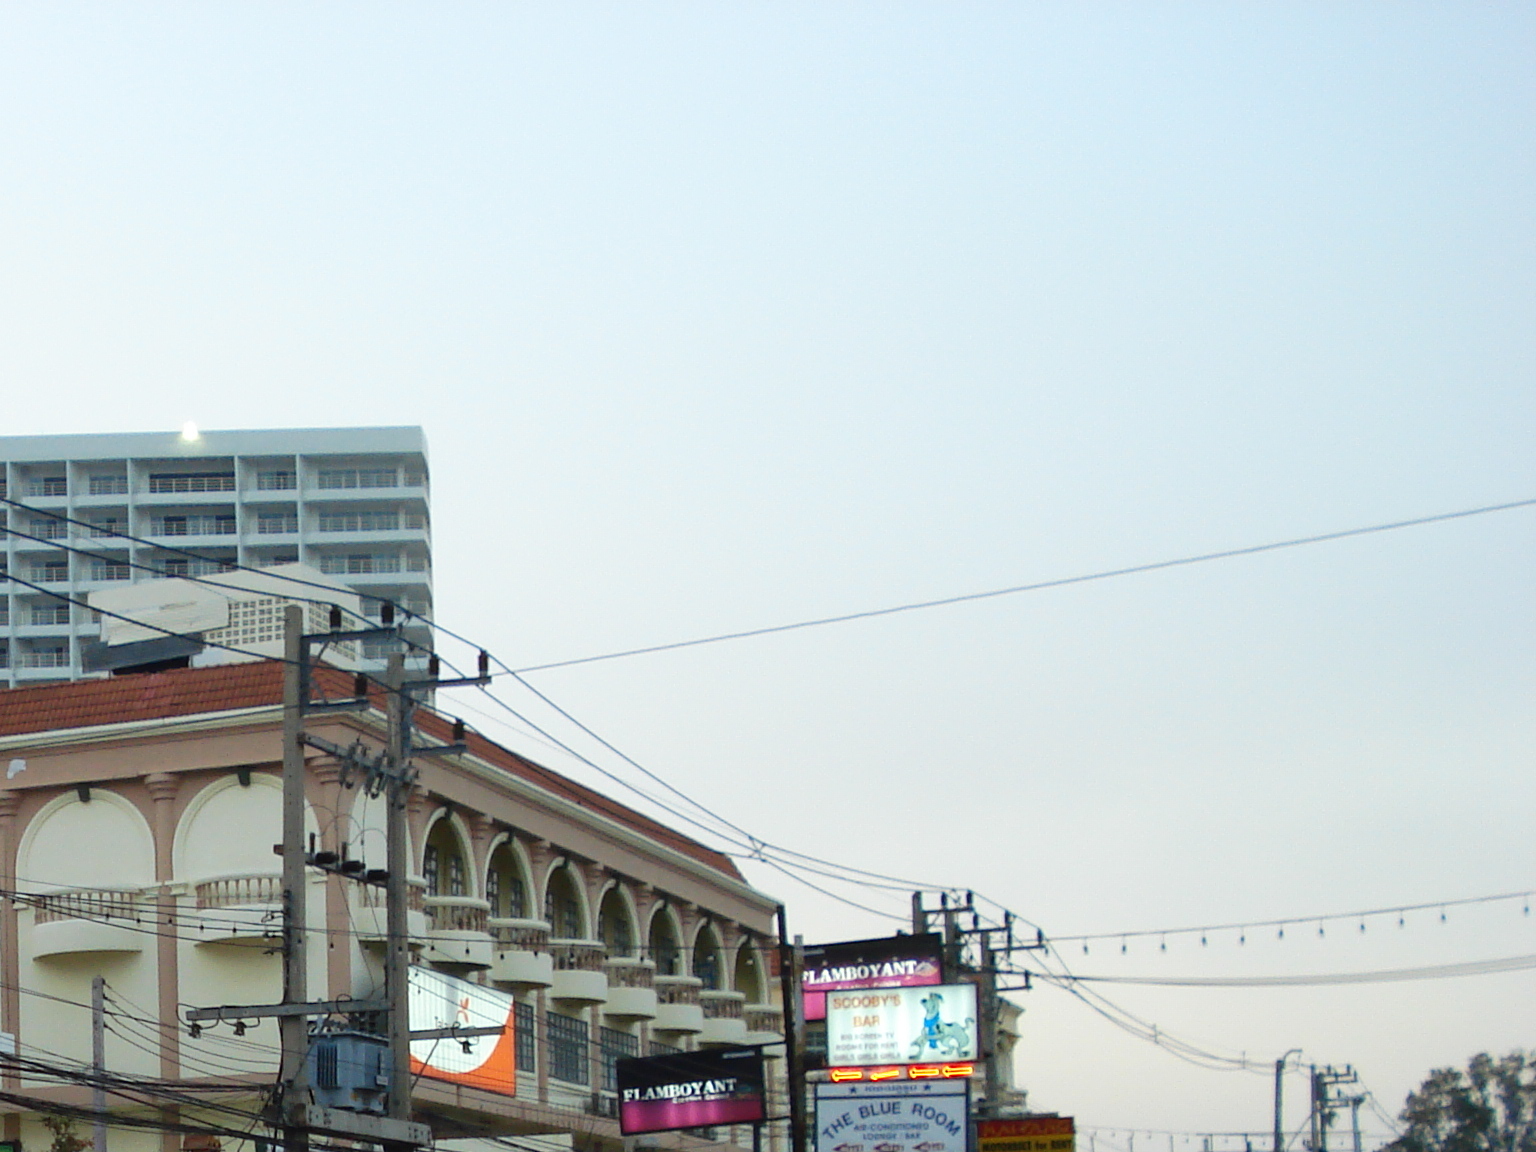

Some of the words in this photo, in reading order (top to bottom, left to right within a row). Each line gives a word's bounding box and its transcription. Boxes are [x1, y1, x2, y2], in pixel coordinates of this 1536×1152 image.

[833, 993, 901, 1010] SCOOBY'S
[853, 1015, 880, 1028] BAR
[622, 1077, 738, 1102] FLAMBOYANT
[822, 1111, 855, 1140] THE
[858, 1101, 902, 1119] BLUE
[911, 1102, 962, 1137] ROOM
